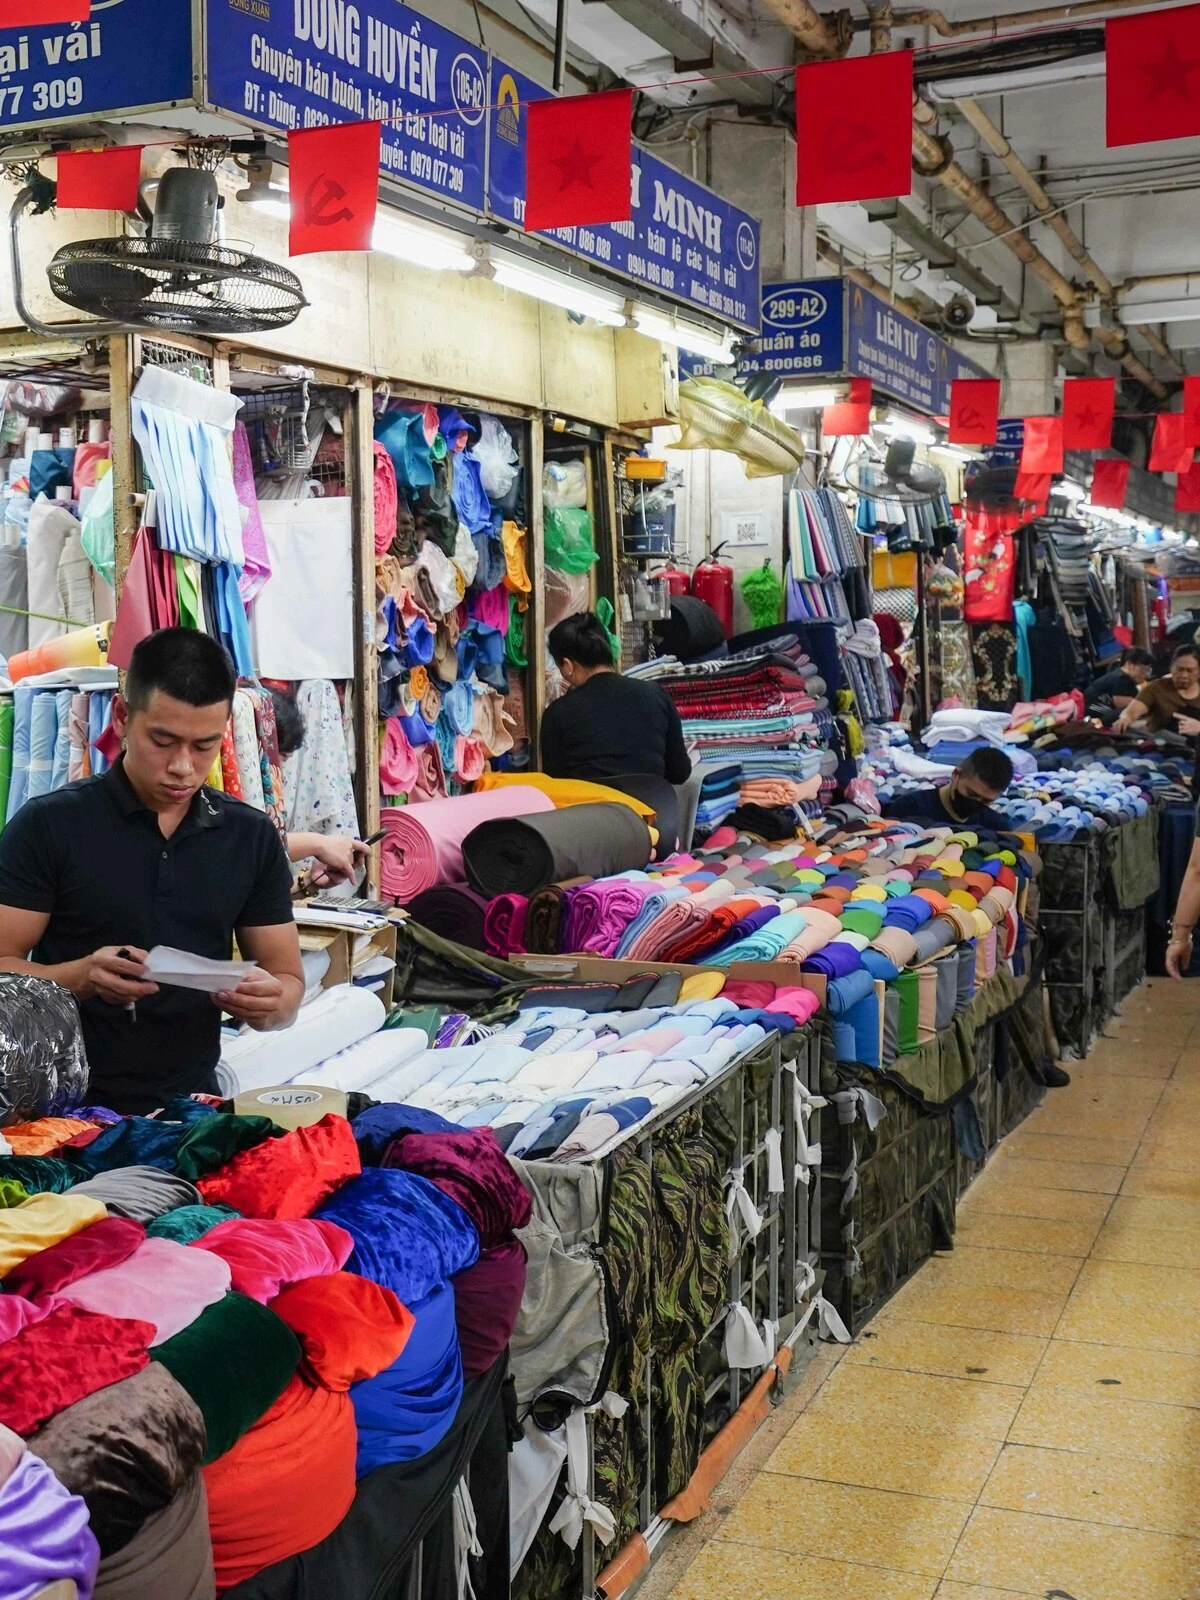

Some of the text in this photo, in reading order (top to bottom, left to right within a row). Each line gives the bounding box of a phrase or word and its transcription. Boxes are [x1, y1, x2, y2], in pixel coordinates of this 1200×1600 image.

[42, 20, 101, 65] vải
[367, 21, 438, 103] HUYỀN
[32, 76, 83, 111] 309
[251, 34, 465, 159] Chuyên bán buôn, bán lẻ các loại vải
[456, 68, 482, 111] 105-A2
[410, 150, 431, 181] 0979
[433, 158, 448, 187] 077
[449, 165, 464, 193] 309
[653, 180, 722, 254] MINH
[579, 228, 595, 254] 086
[647, 227, 666, 256] bán
[671, 236, 681, 262] lẻ
[686, 246, 702, 271] các
[724, 264, 737, 289] vải
[769, 296, 819, 319] 299-A2
[800, 330, 821, 348] áo
[876, 310, 902, 351] LIÊN
